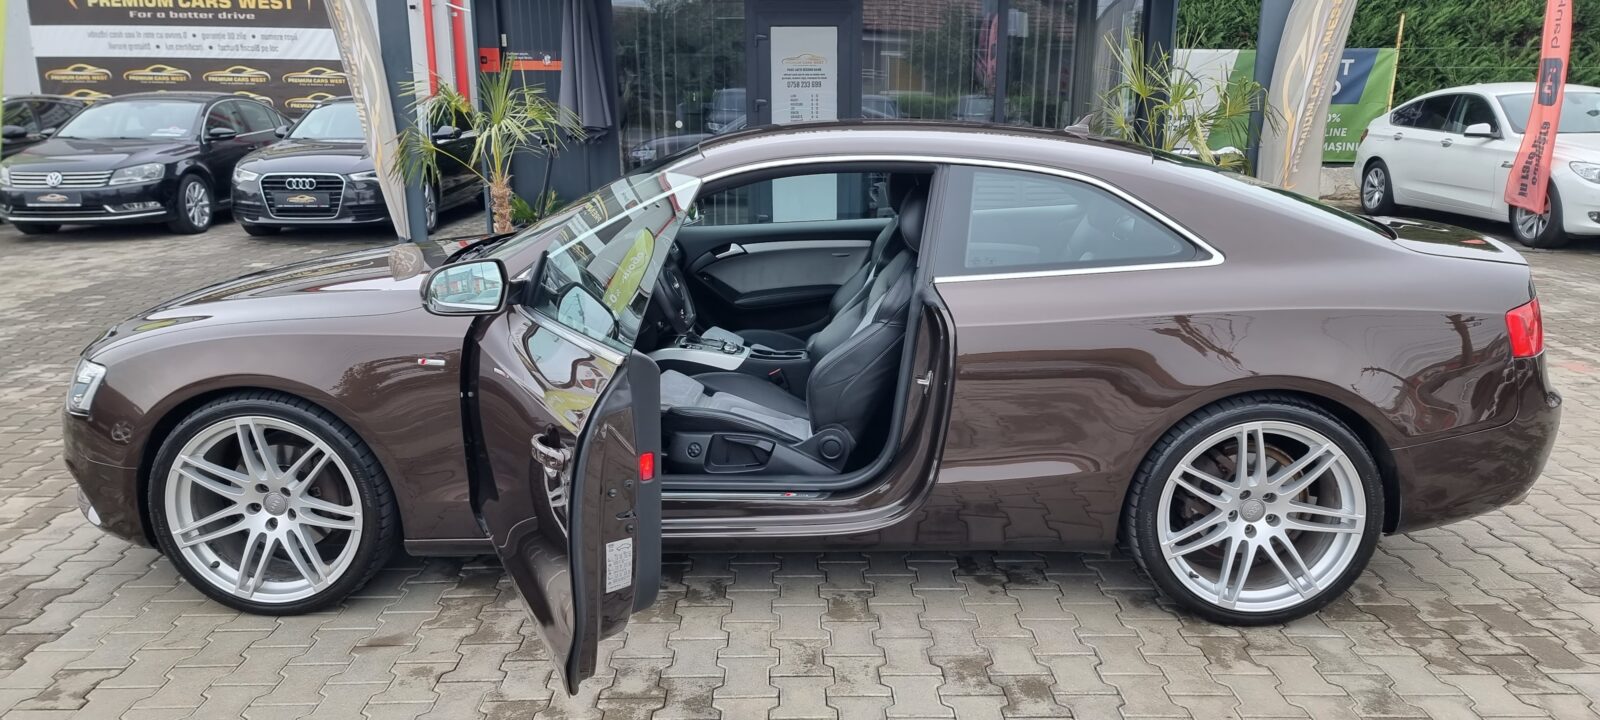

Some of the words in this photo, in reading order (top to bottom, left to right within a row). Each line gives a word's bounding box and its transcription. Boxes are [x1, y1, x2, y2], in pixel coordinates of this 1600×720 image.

[129, 10, 153, 18] For
[169, 11, 214, 19] better
[218, 12, 256, 20] drive
[1325, 128, 1347, 137] LINE
